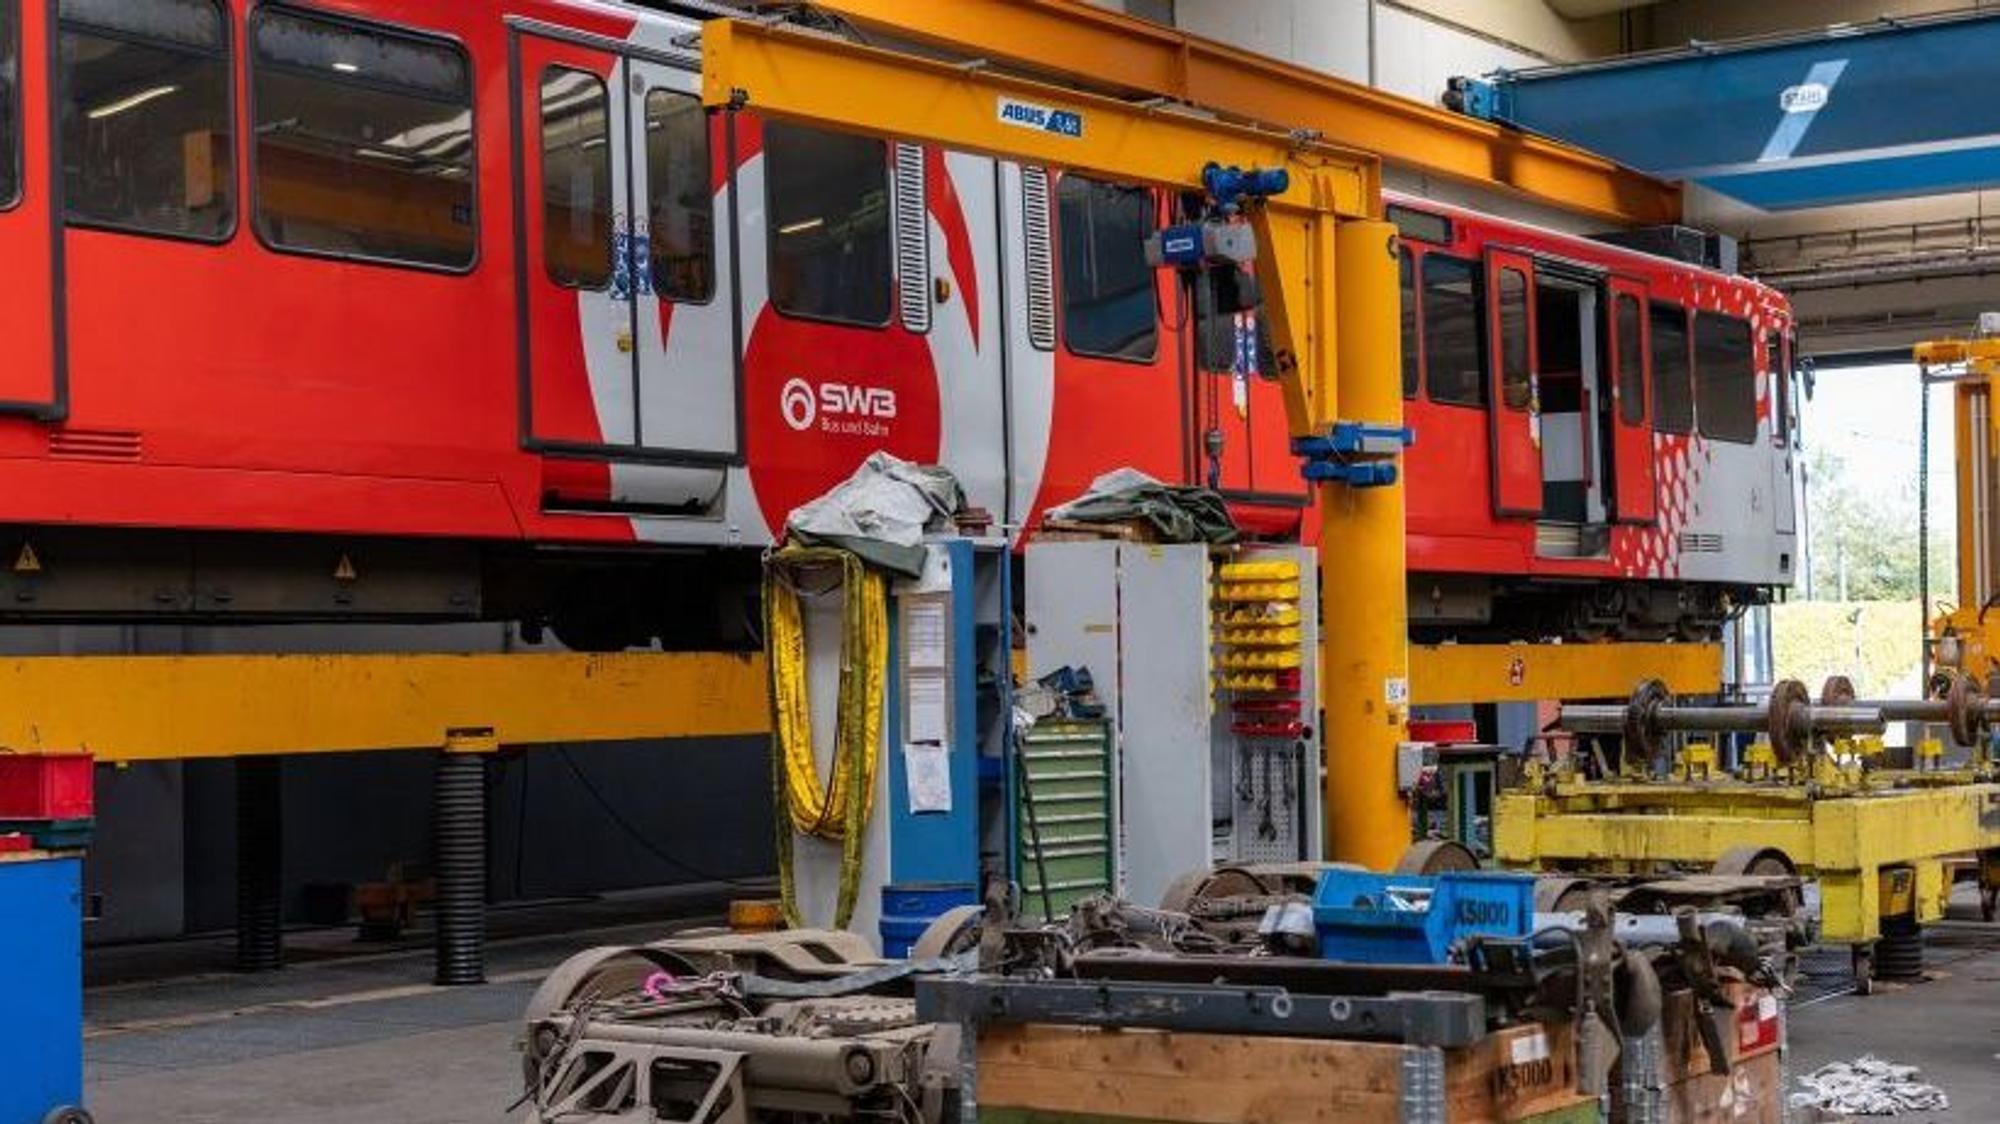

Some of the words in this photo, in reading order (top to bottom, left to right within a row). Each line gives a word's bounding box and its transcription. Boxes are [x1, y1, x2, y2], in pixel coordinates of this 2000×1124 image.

[1001, 103, 1047, 126] ABUS
[819, 383, 897, 418] SWB
[821, 417, 840, 433] Bus
[842, 420, 862, 436] und
